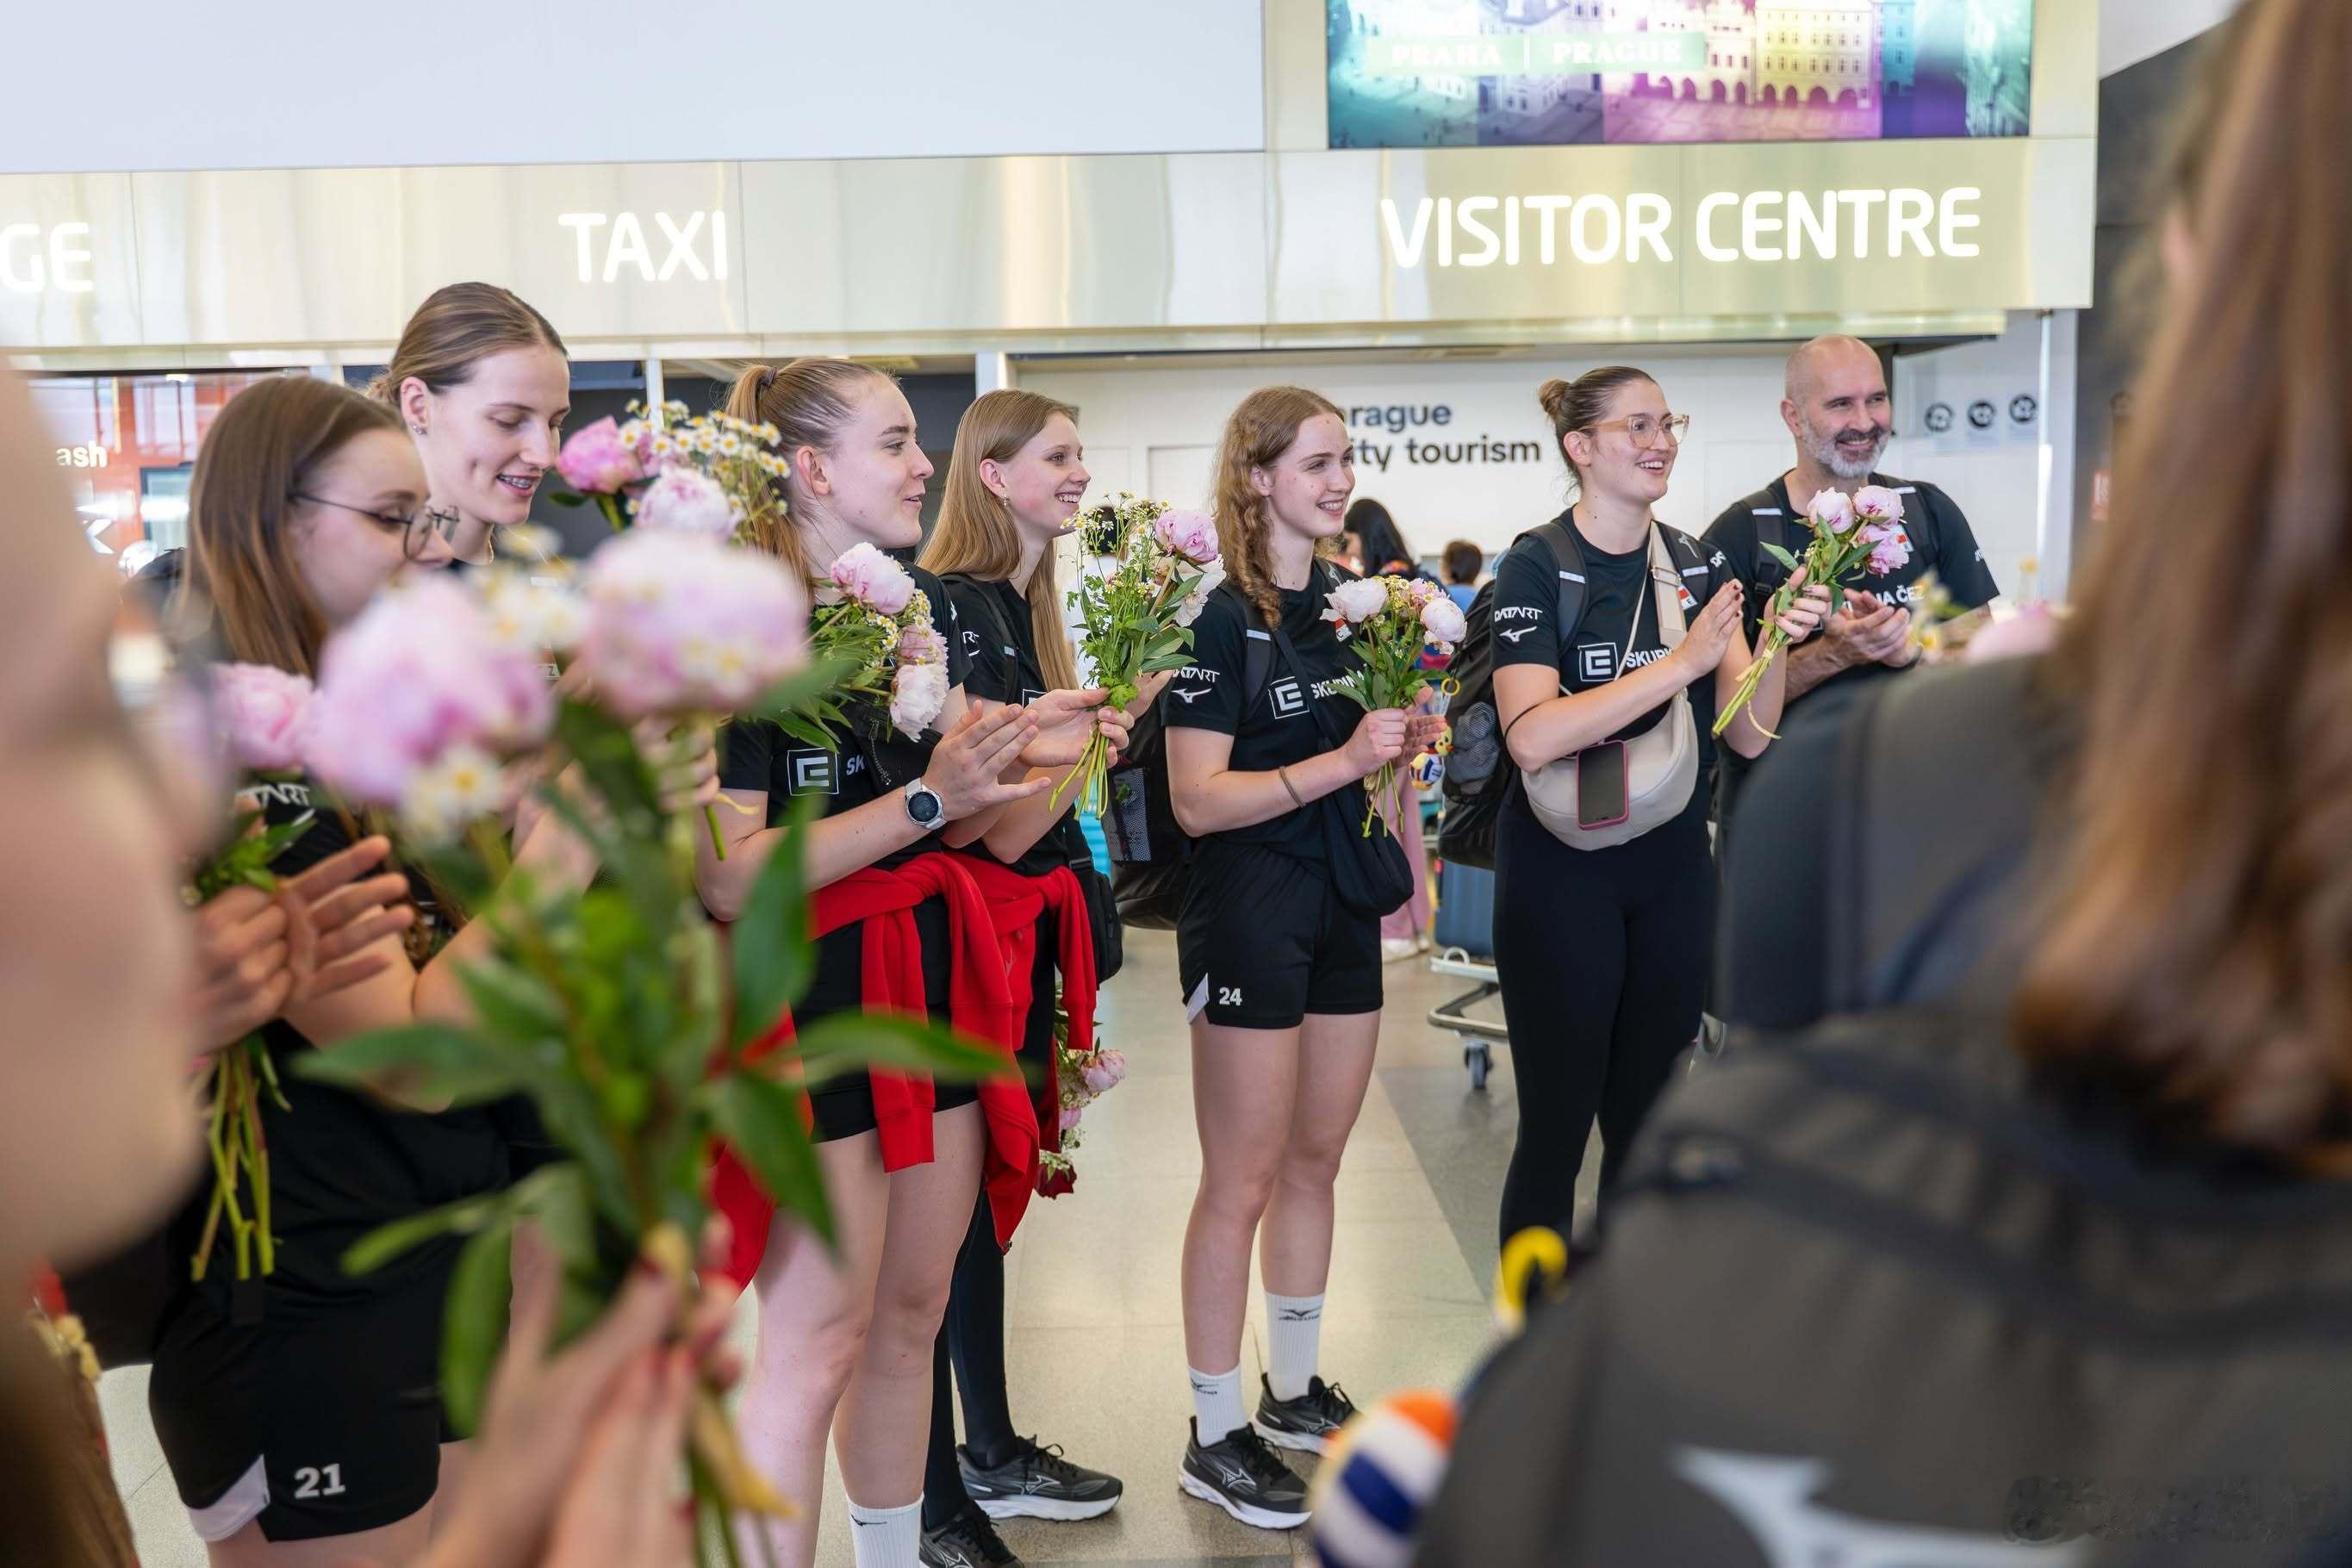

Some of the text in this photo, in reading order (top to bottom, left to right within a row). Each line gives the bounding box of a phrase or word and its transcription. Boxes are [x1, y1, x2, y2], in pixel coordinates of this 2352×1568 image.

[1391, 40, 1682, 67] PRAHA PRAGUE
[1381, 187, 1982, 268] VISITOR CENTRE
[0, 221, 94, 292] GE
[557, 211, 728, 283] TAXI
[1347, 404, 1452, 433] rague
[55, 440, 108, 468] ash
[1349, 433, 1541, 472] ity tourism
[1494, 606, 1543, 622] DATART
[1219, 986, 1242, 1006] 24
[294, 1463, 345, 1499] 21
